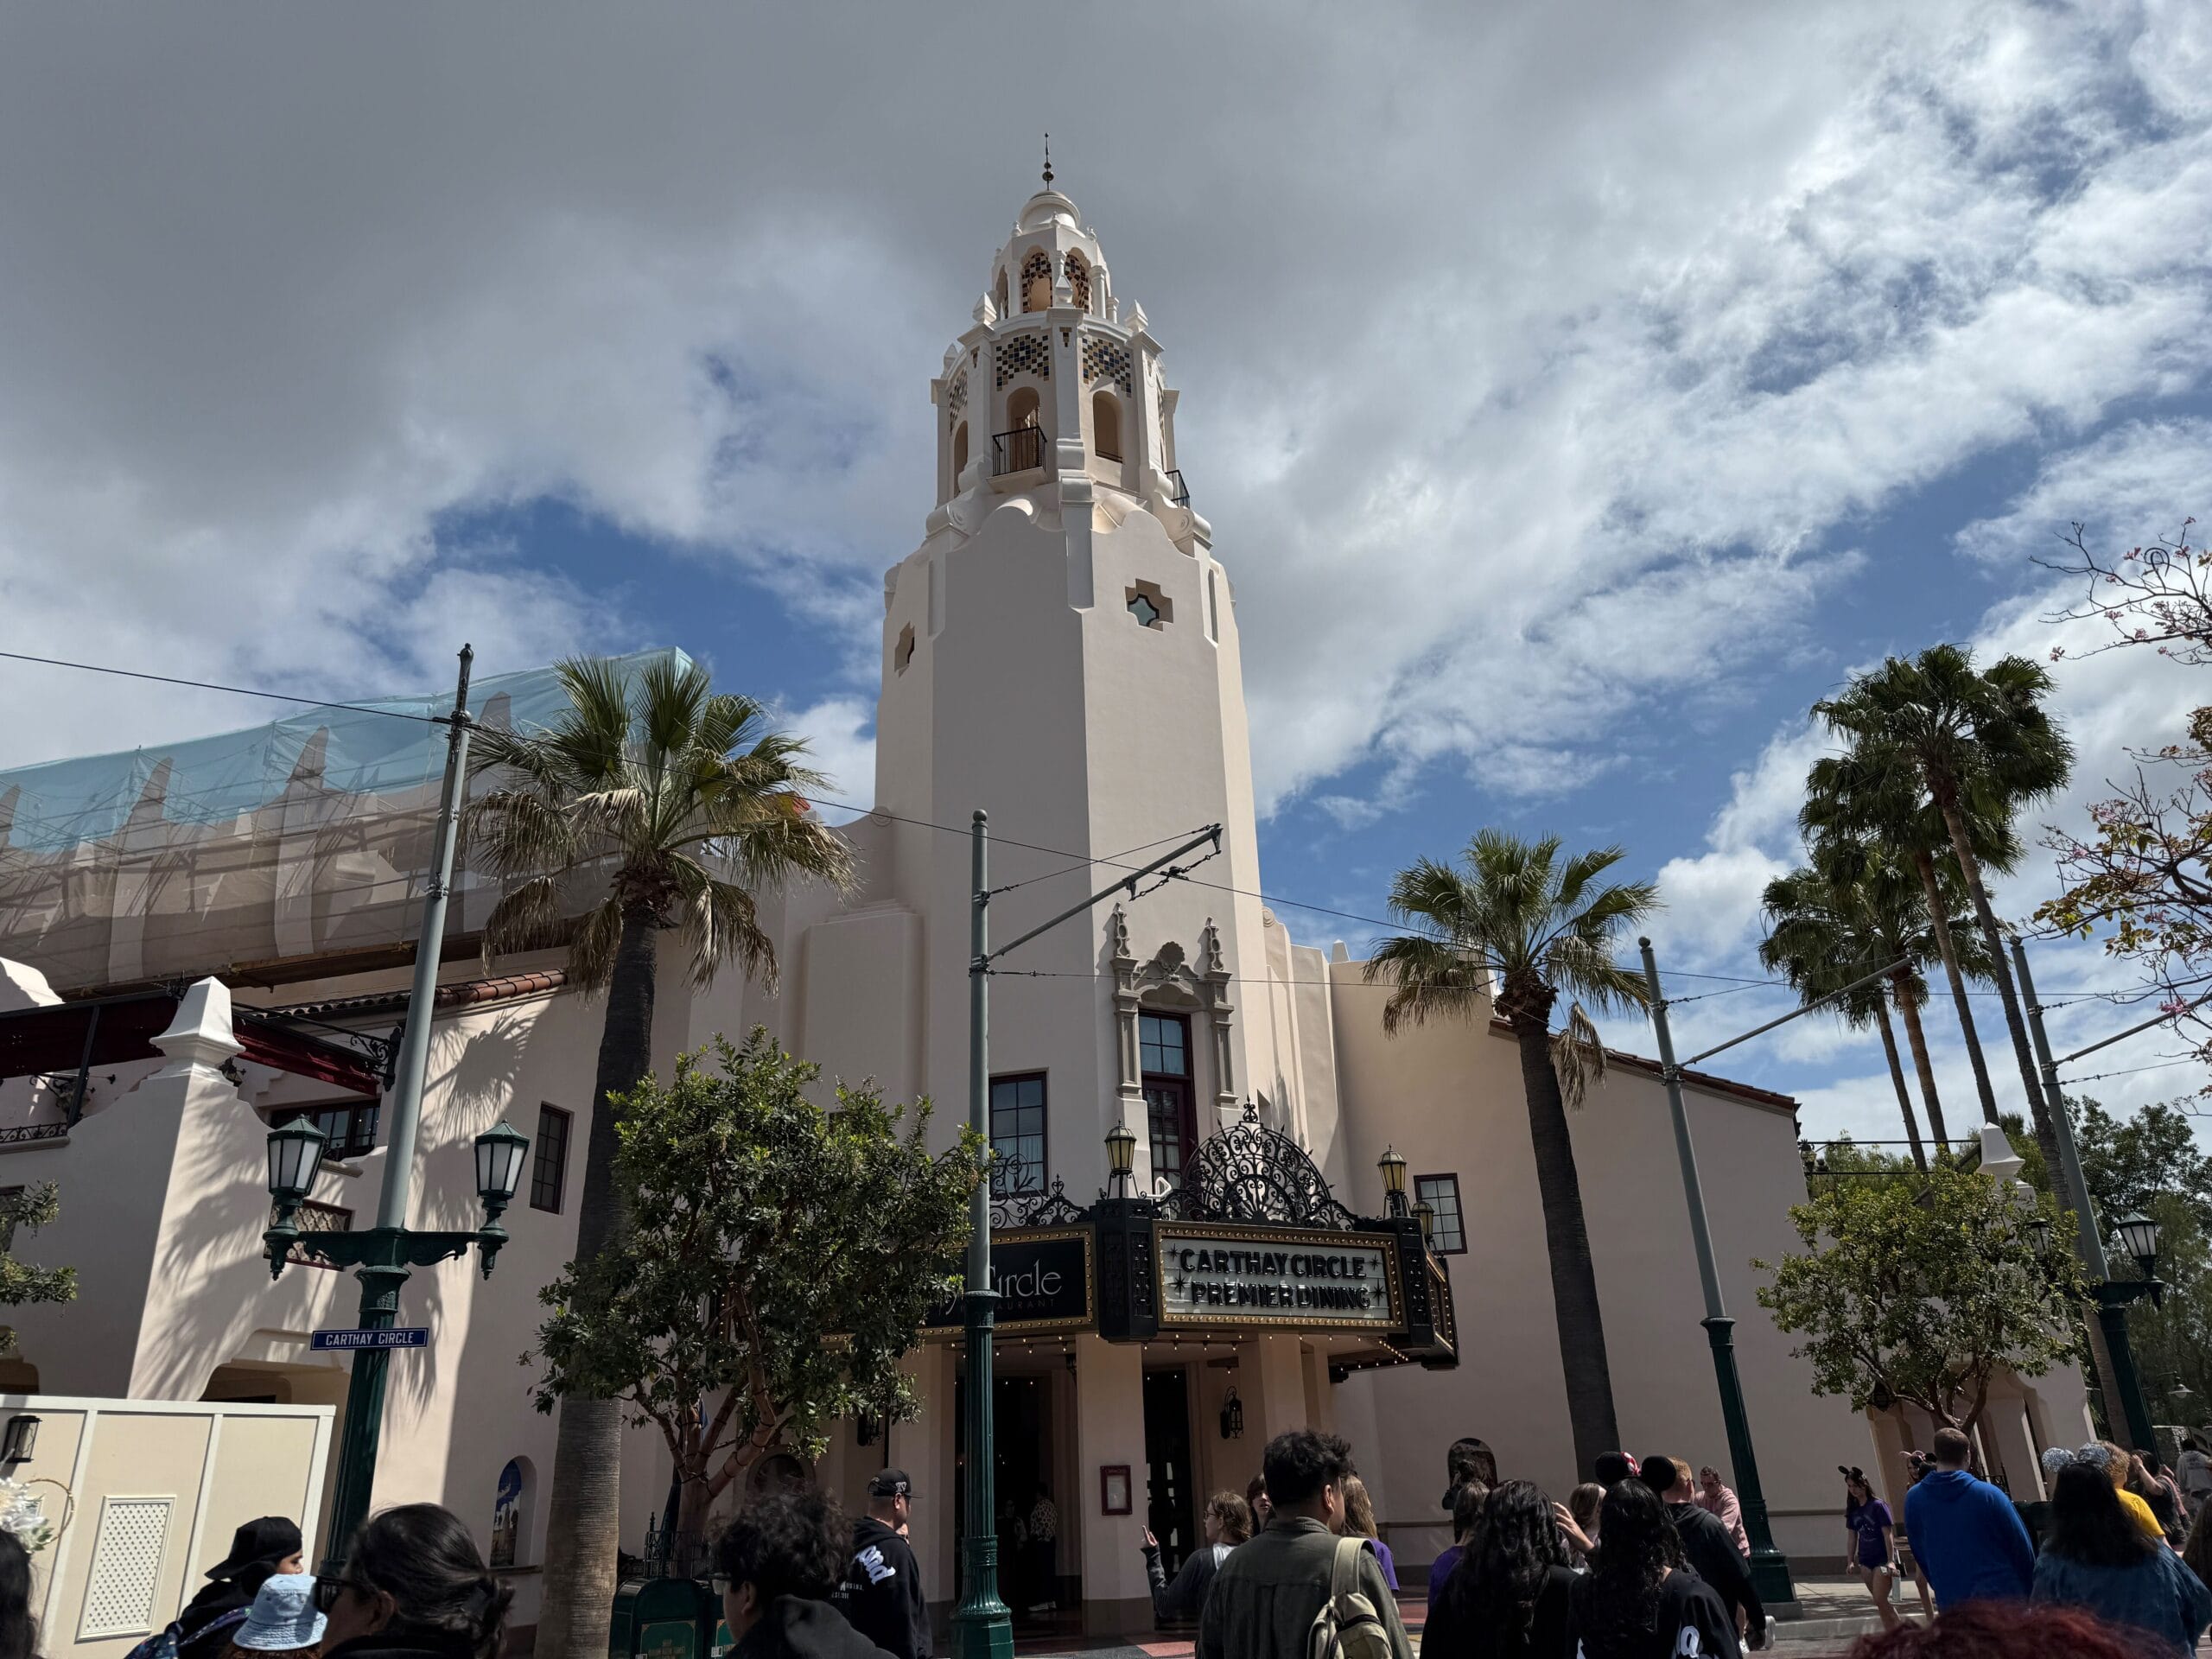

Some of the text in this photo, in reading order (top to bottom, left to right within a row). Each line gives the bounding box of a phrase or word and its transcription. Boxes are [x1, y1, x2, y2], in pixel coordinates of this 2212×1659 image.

[989, 1258, 1062, 1298] ircle
[1180, 1248, 1367, 1280] CARTHAY CIRCLE
[1191, 1281, 1371, 1311] PREMIER DINING
[325, 1332, 414, 1346] CARTHAY CIRCLE
